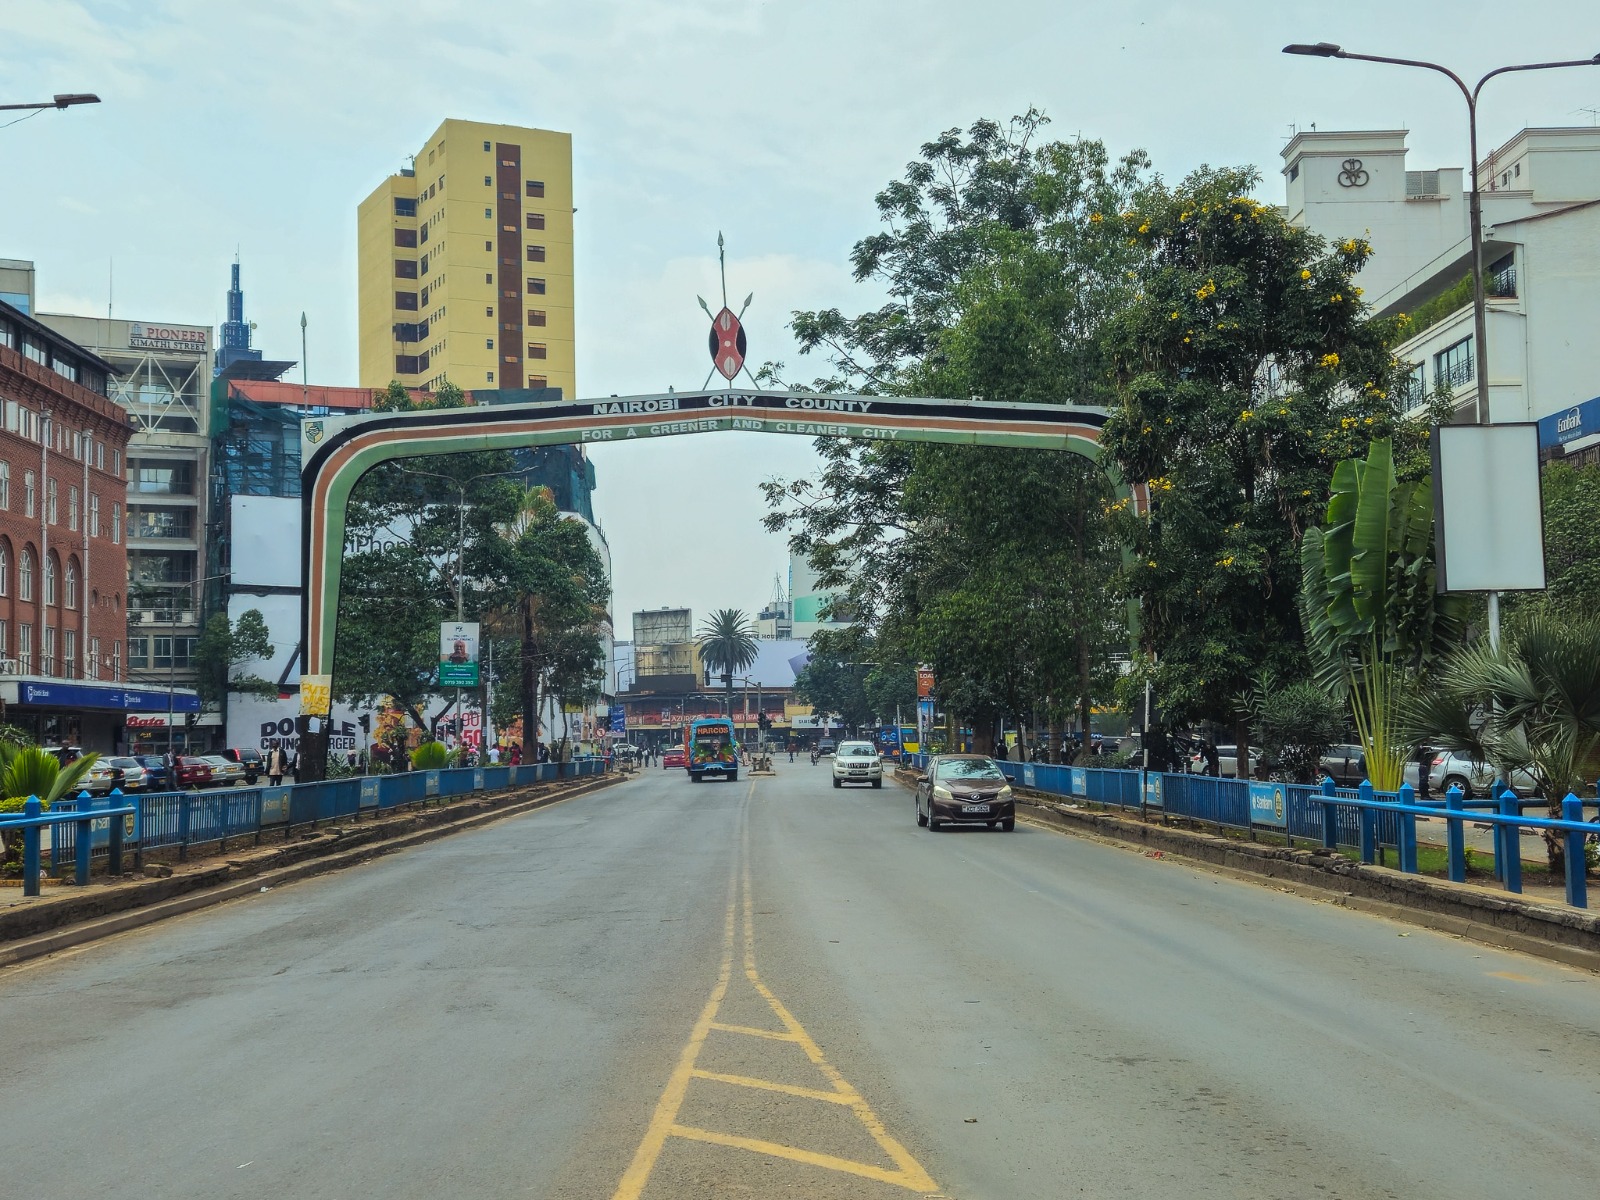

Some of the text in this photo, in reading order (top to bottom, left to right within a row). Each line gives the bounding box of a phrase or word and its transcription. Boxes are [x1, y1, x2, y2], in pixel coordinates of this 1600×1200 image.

[147, 327, 205, 342] PIONEER
[130, 338, 205, 351] KIMATHI STREET
[593, 394, 872, 415] NAIROBI CITY COUNTY
[581, 420, 899, 440] FOR A GREENER AND CLEANER CITY
[127, 716, 165, 726] Bata
[260, 717, 356, 738] DOLE
[697, 727, 729, 735] NARCOS
